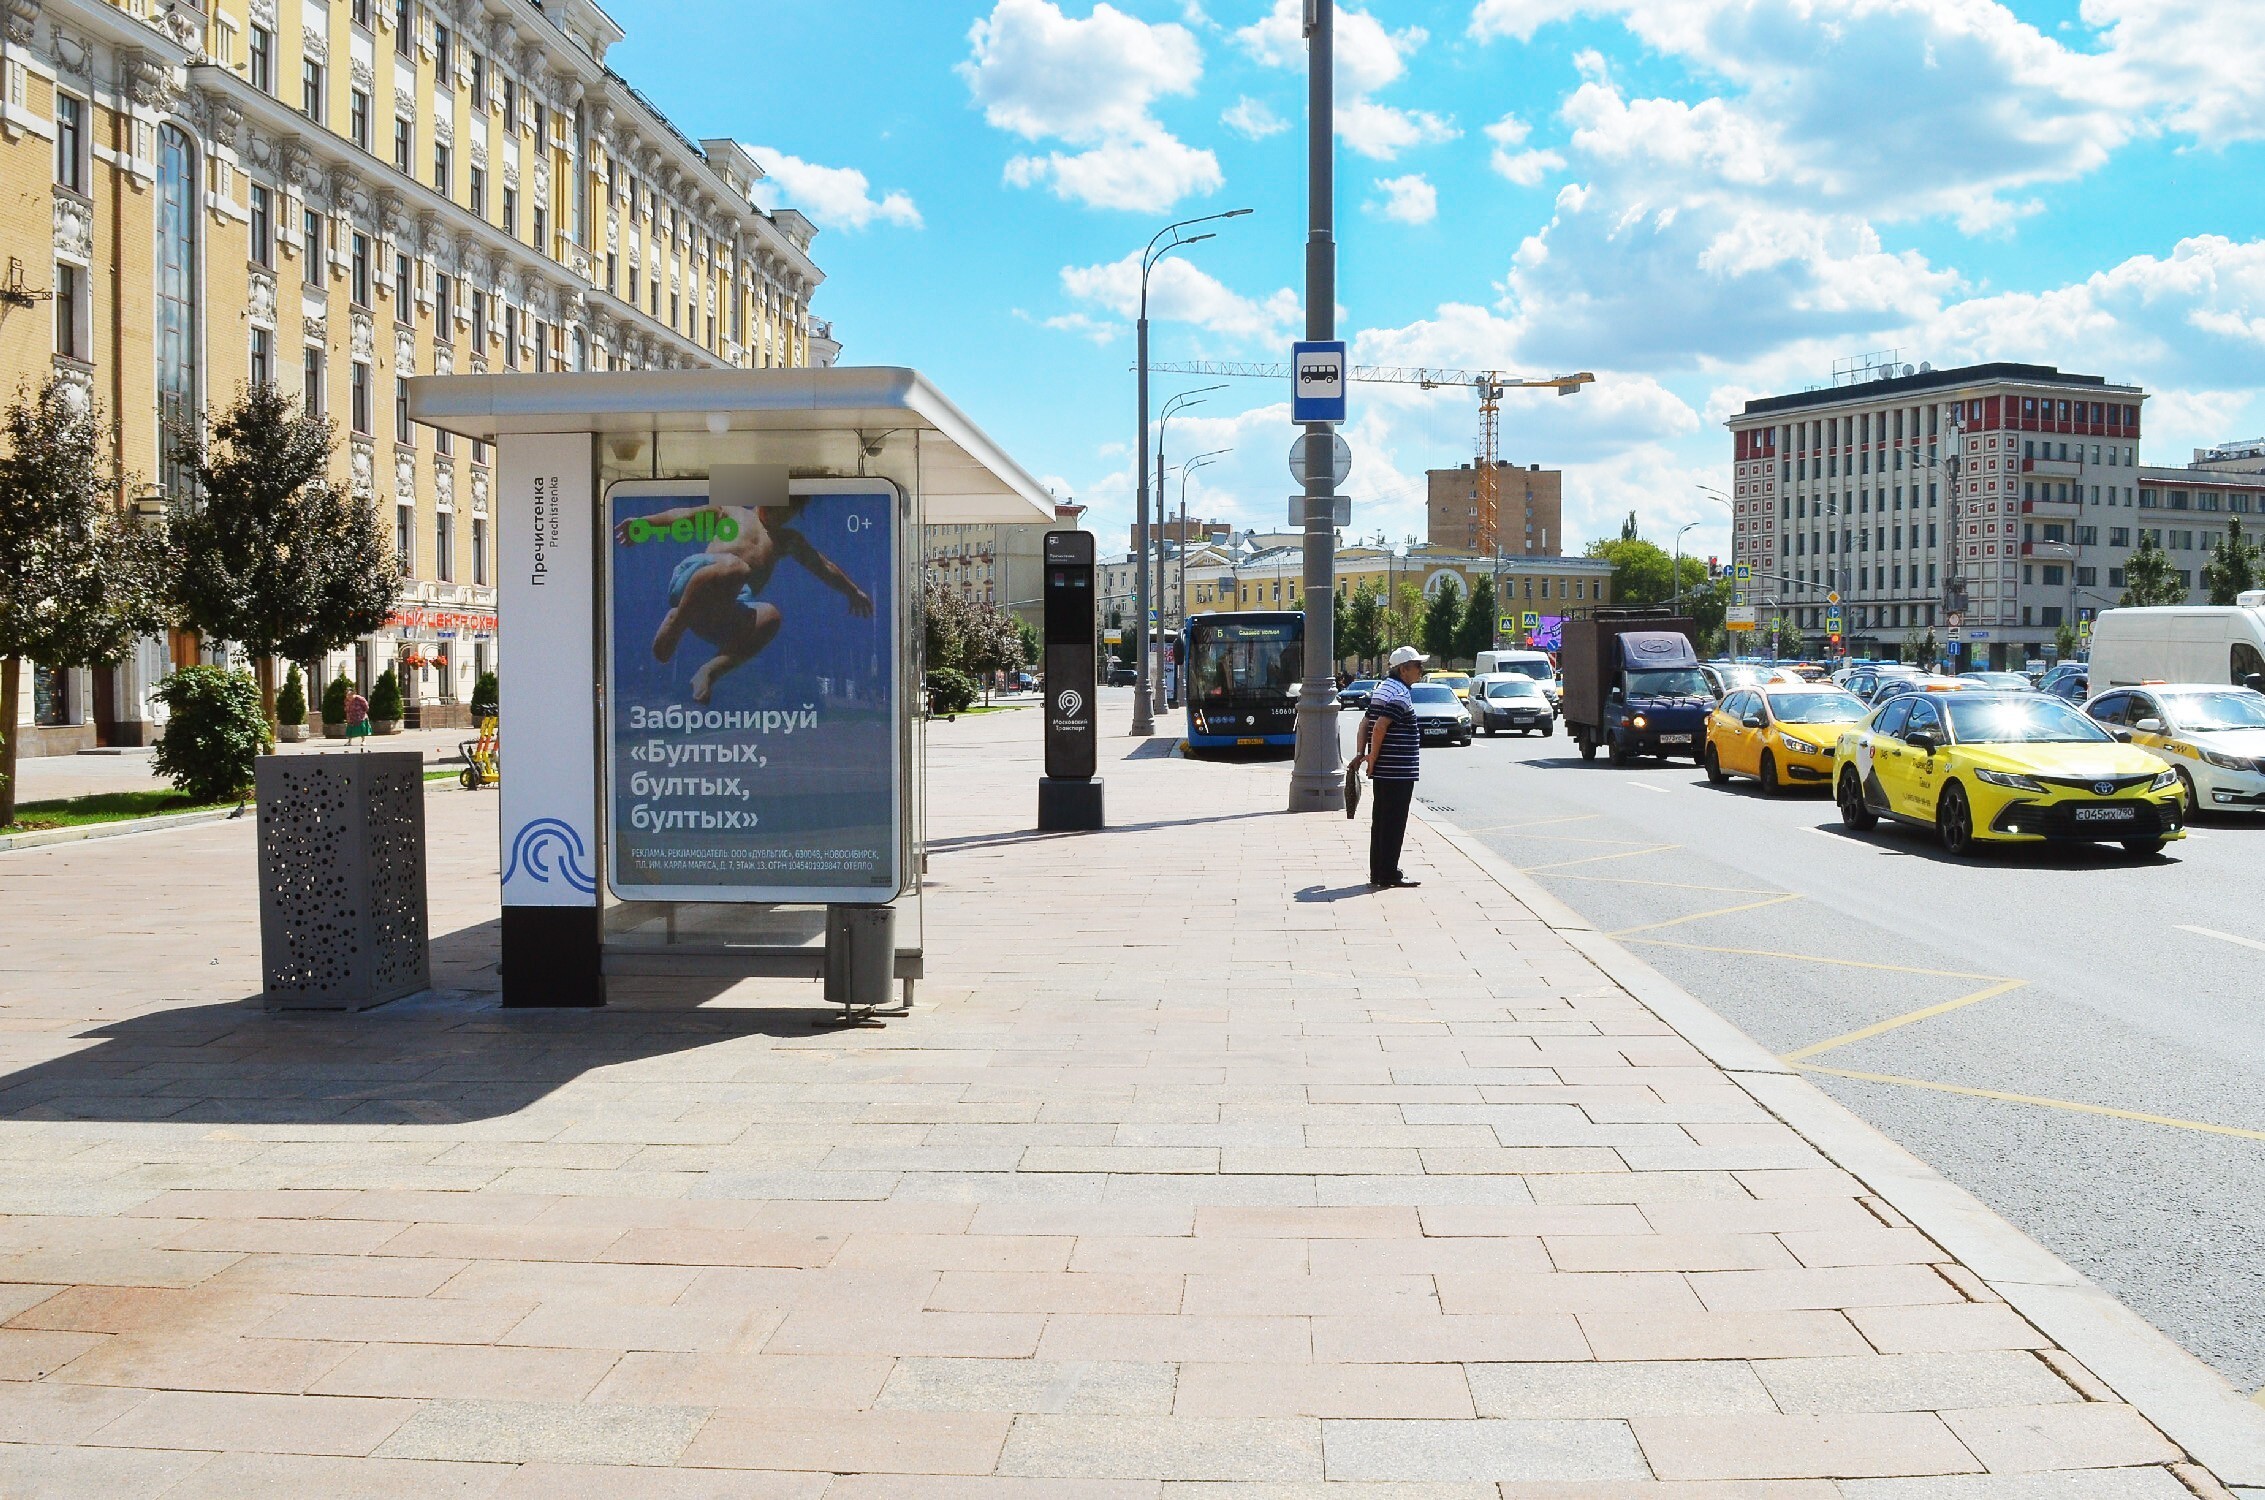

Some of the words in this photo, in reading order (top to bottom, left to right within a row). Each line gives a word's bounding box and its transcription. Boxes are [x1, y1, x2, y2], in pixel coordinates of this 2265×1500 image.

[549, 476, 559, 548] Prechistenka
[847, 514, 872, 533] 0+
[532, 477, 547, 586] Пречистенка
[630, 703, 818, 734] Забронируй
[630, 739, 768, 768] «Бултых,
[630, 771, 750, 801] бултых,
[631, 803, 759, 834] бултых»
[664, 861, 686, 869] КАРЛА
[768, 861, 786, 870] ОГРН
[731, 849, 747, 858] ООО
